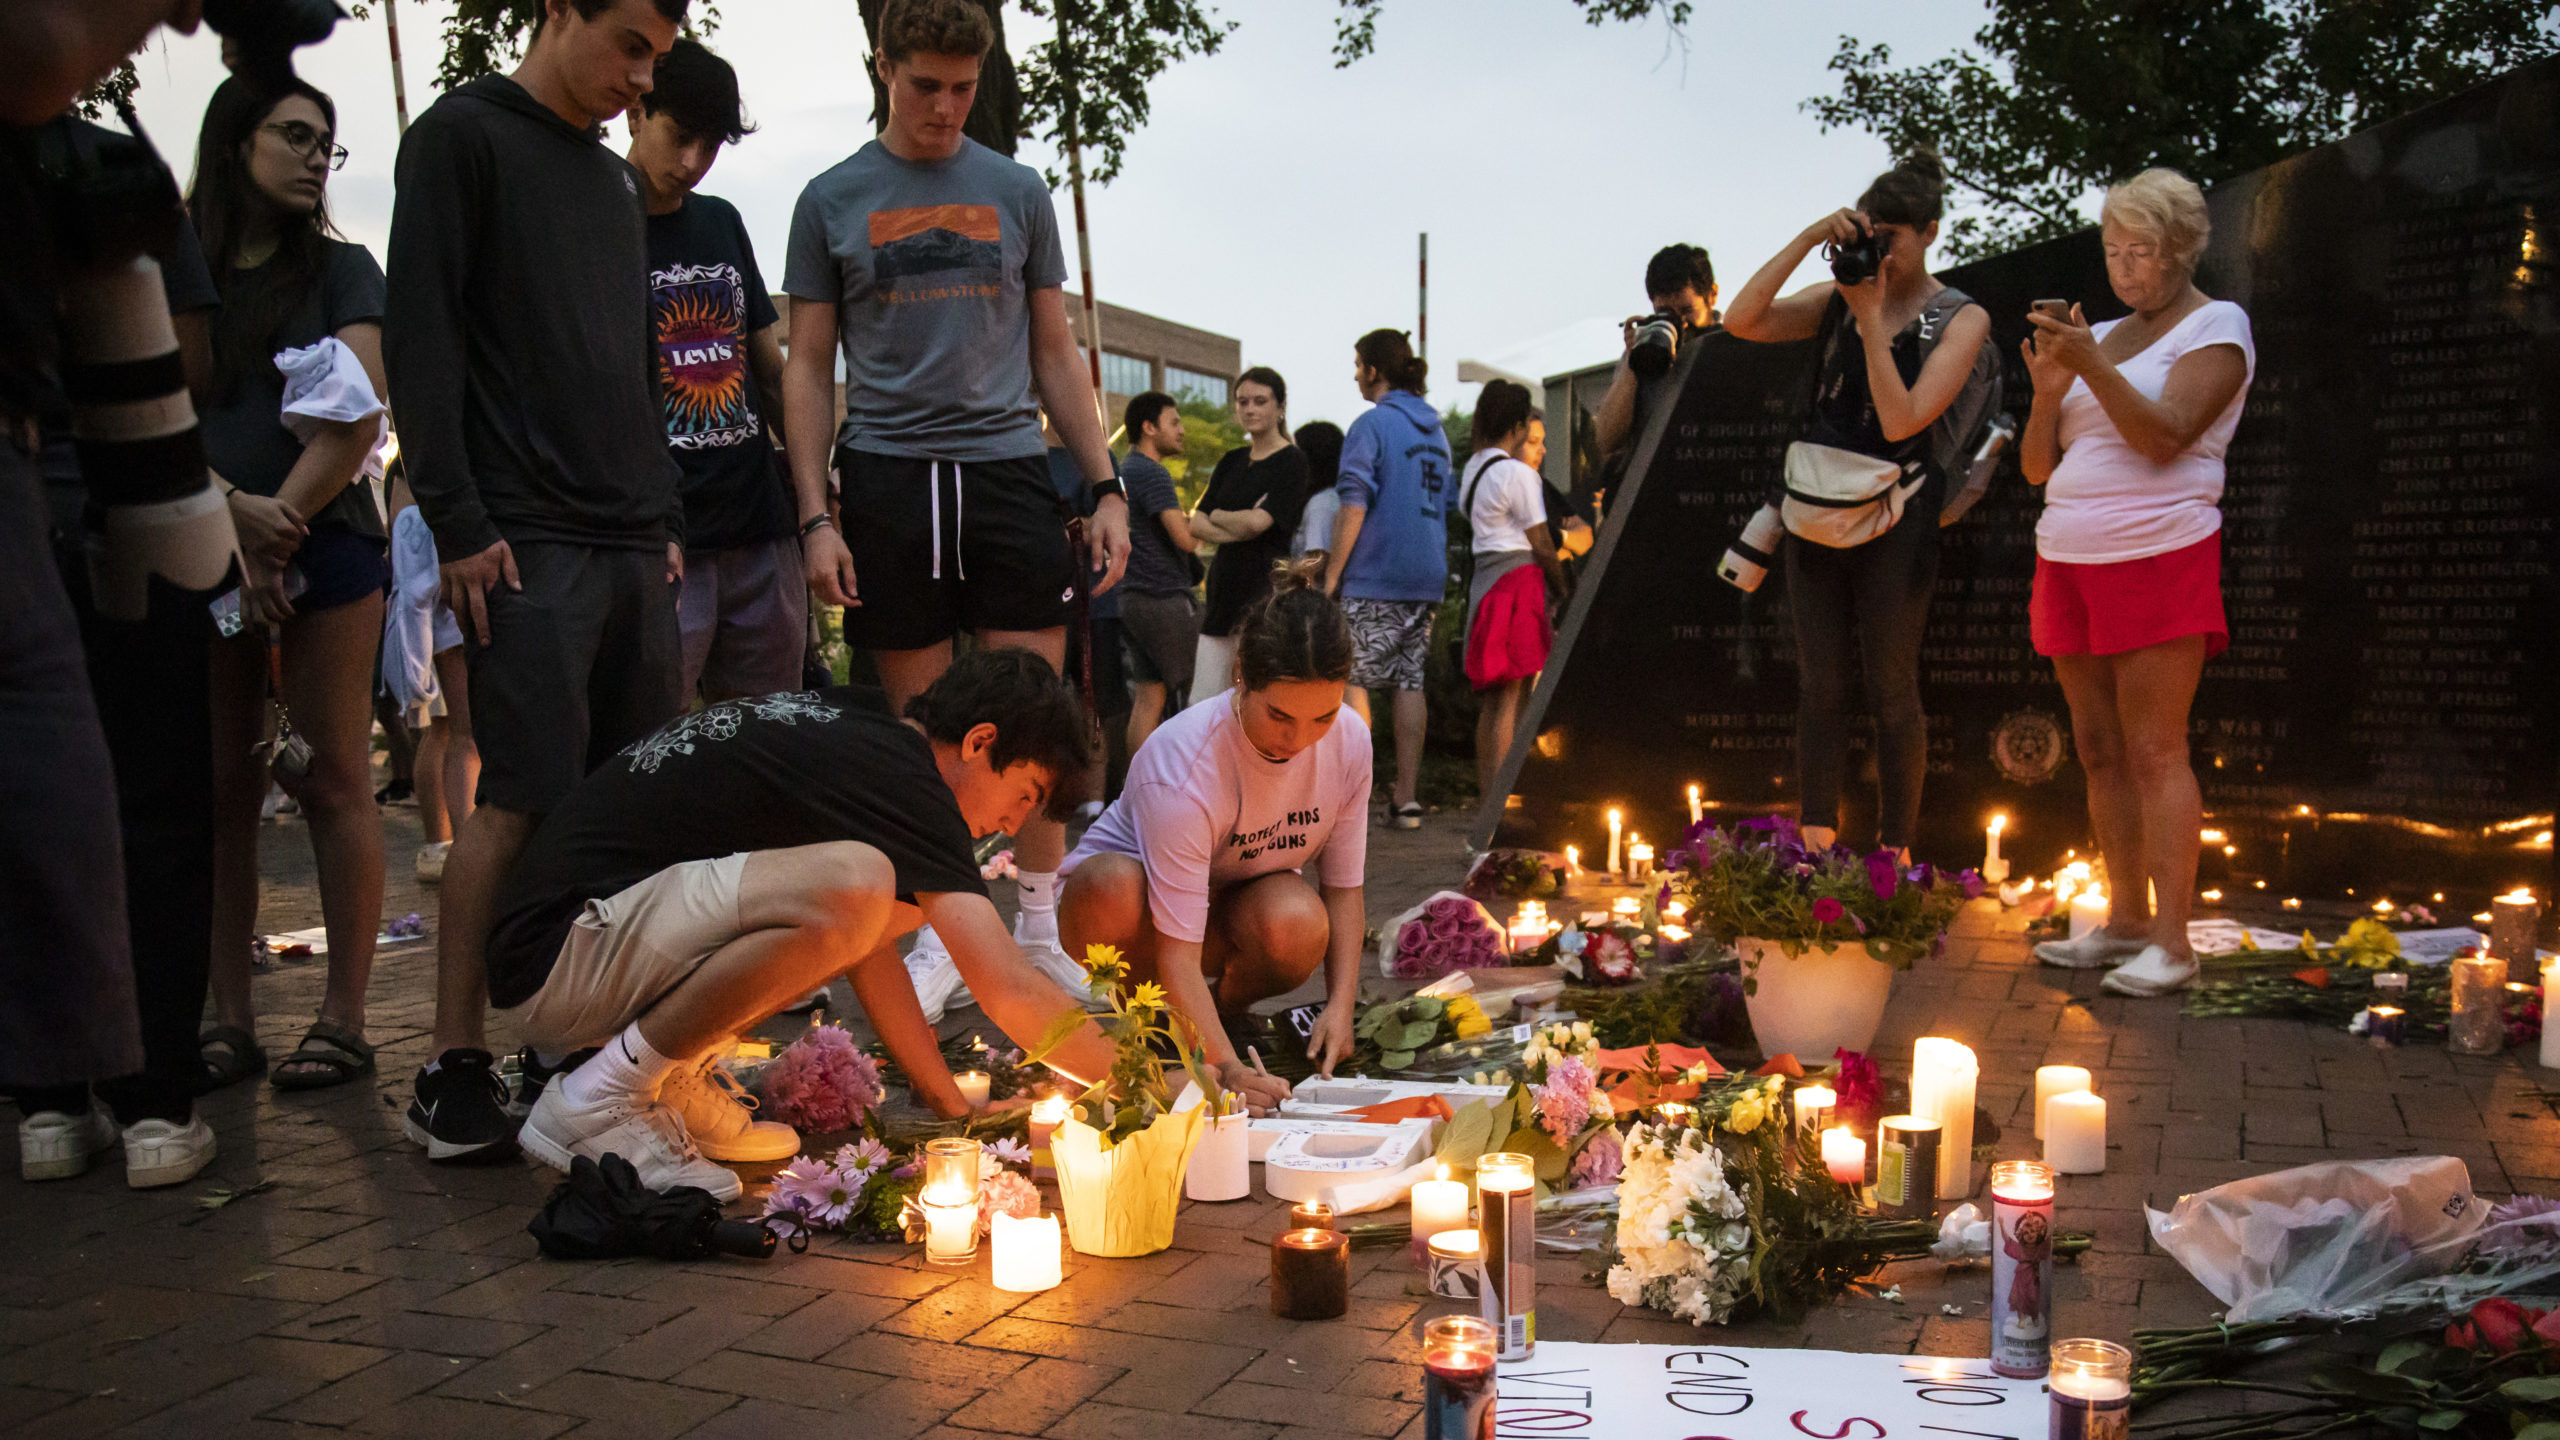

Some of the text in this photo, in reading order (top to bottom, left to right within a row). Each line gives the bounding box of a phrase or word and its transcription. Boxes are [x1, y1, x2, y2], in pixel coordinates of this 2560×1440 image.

[878, 285, 1000, 303] YELLOWSTONE
[1930, 669, 2022, 684] HIGHLAND
[1230, 808, 1320, 847] PROTECT KIDS
[1240, 834, 1306, 861] NOT GUNS
[1665, 1351, 1754, 1415] END
